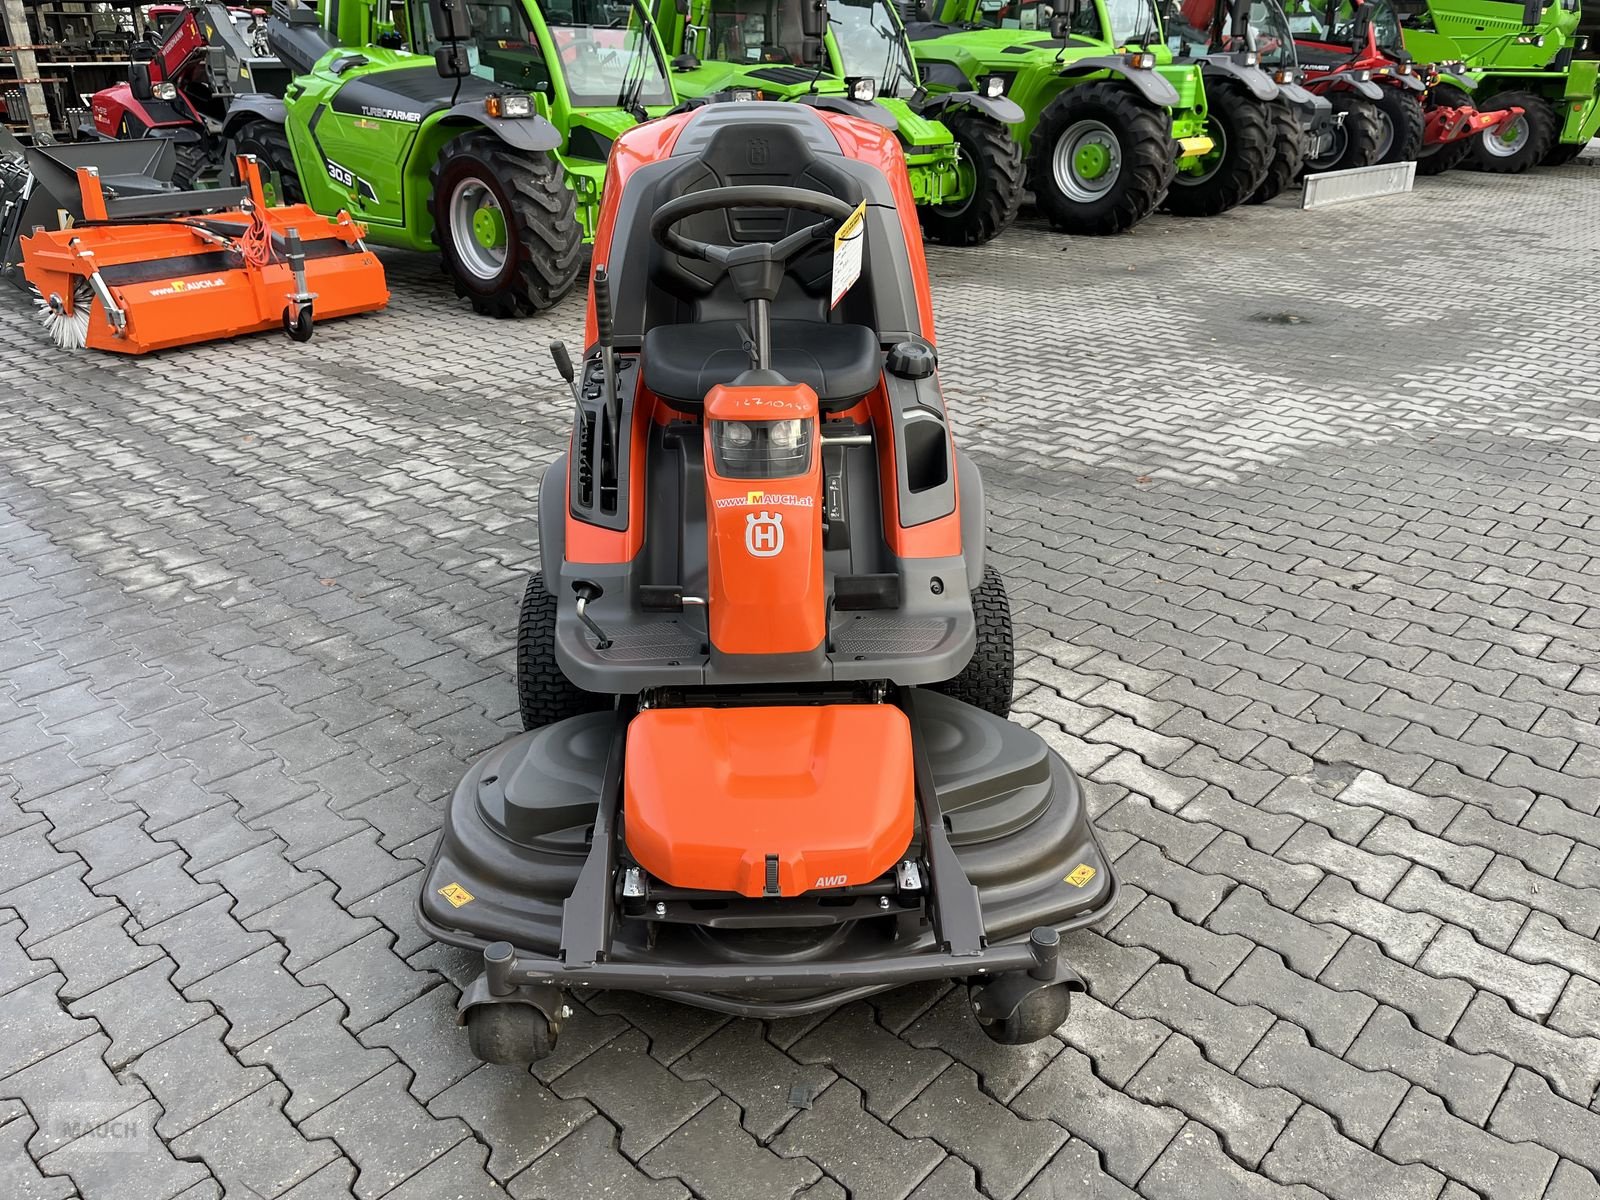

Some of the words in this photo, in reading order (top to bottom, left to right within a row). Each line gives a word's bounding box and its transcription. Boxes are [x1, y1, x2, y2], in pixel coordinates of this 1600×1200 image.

[361, 105, 421, 122] TURBOFARMER
[328, 164, 353, 187] 30.9
[716, 491, 813, 508] www.MAUCH.at
[815, 874, 848, 888] AWD
